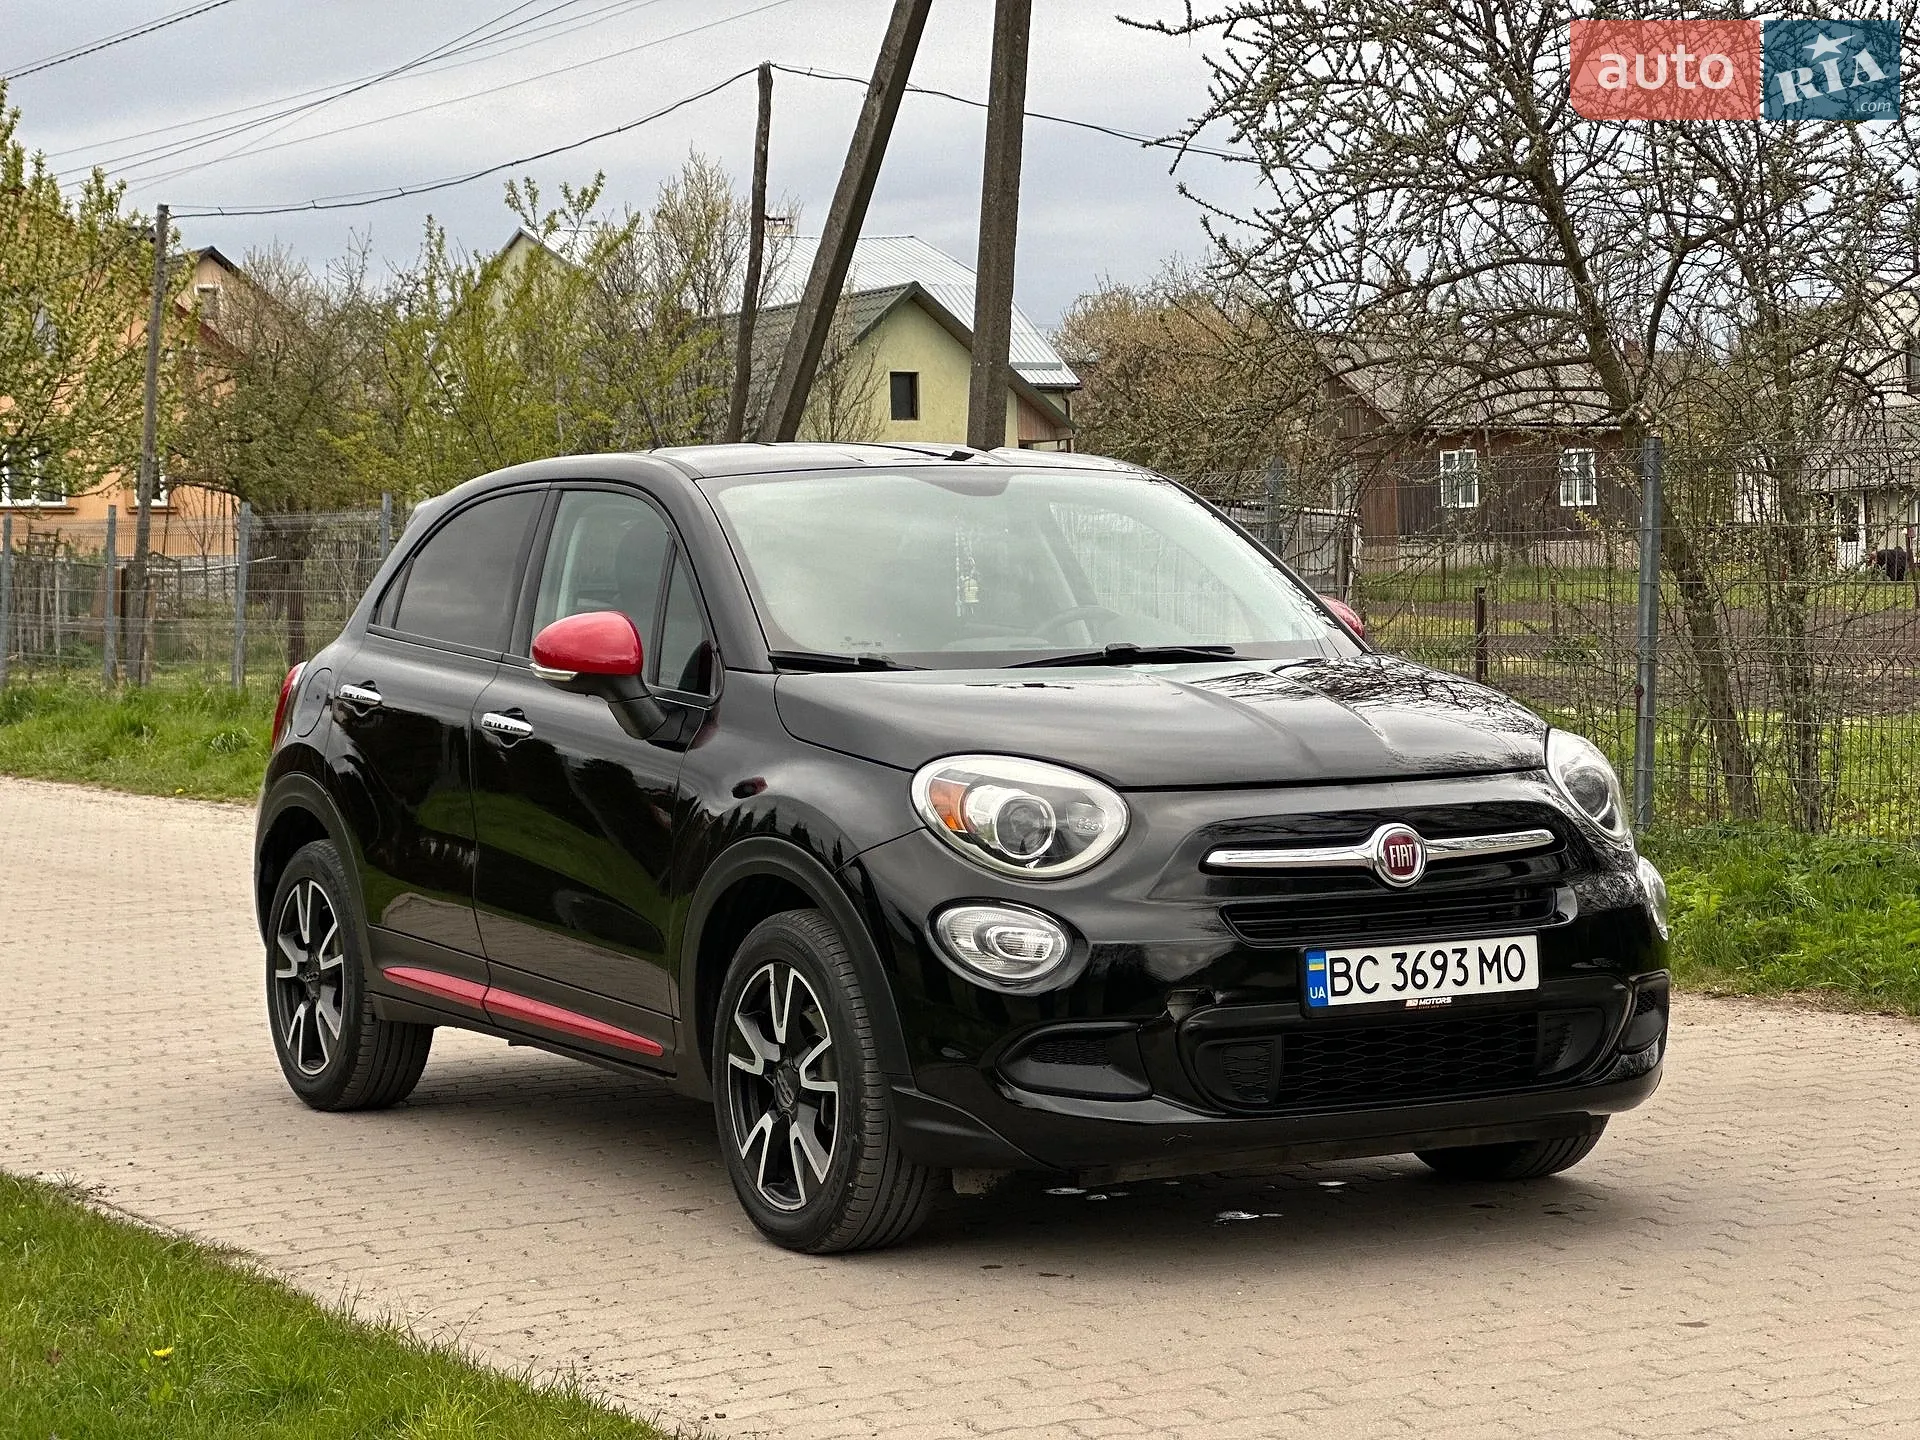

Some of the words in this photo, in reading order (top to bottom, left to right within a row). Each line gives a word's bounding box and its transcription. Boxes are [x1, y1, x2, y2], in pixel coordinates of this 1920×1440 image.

[1388, 843, 1414, 868] FIAT
[1328, 954, 1380, 997] BC
[1391, 946, 1469, 992] 3693
[1477, 943, 1526, 986] MO
[1309, 985, 1327, 999] UA
[1418, 996, 1452, 1006] MOTORS
